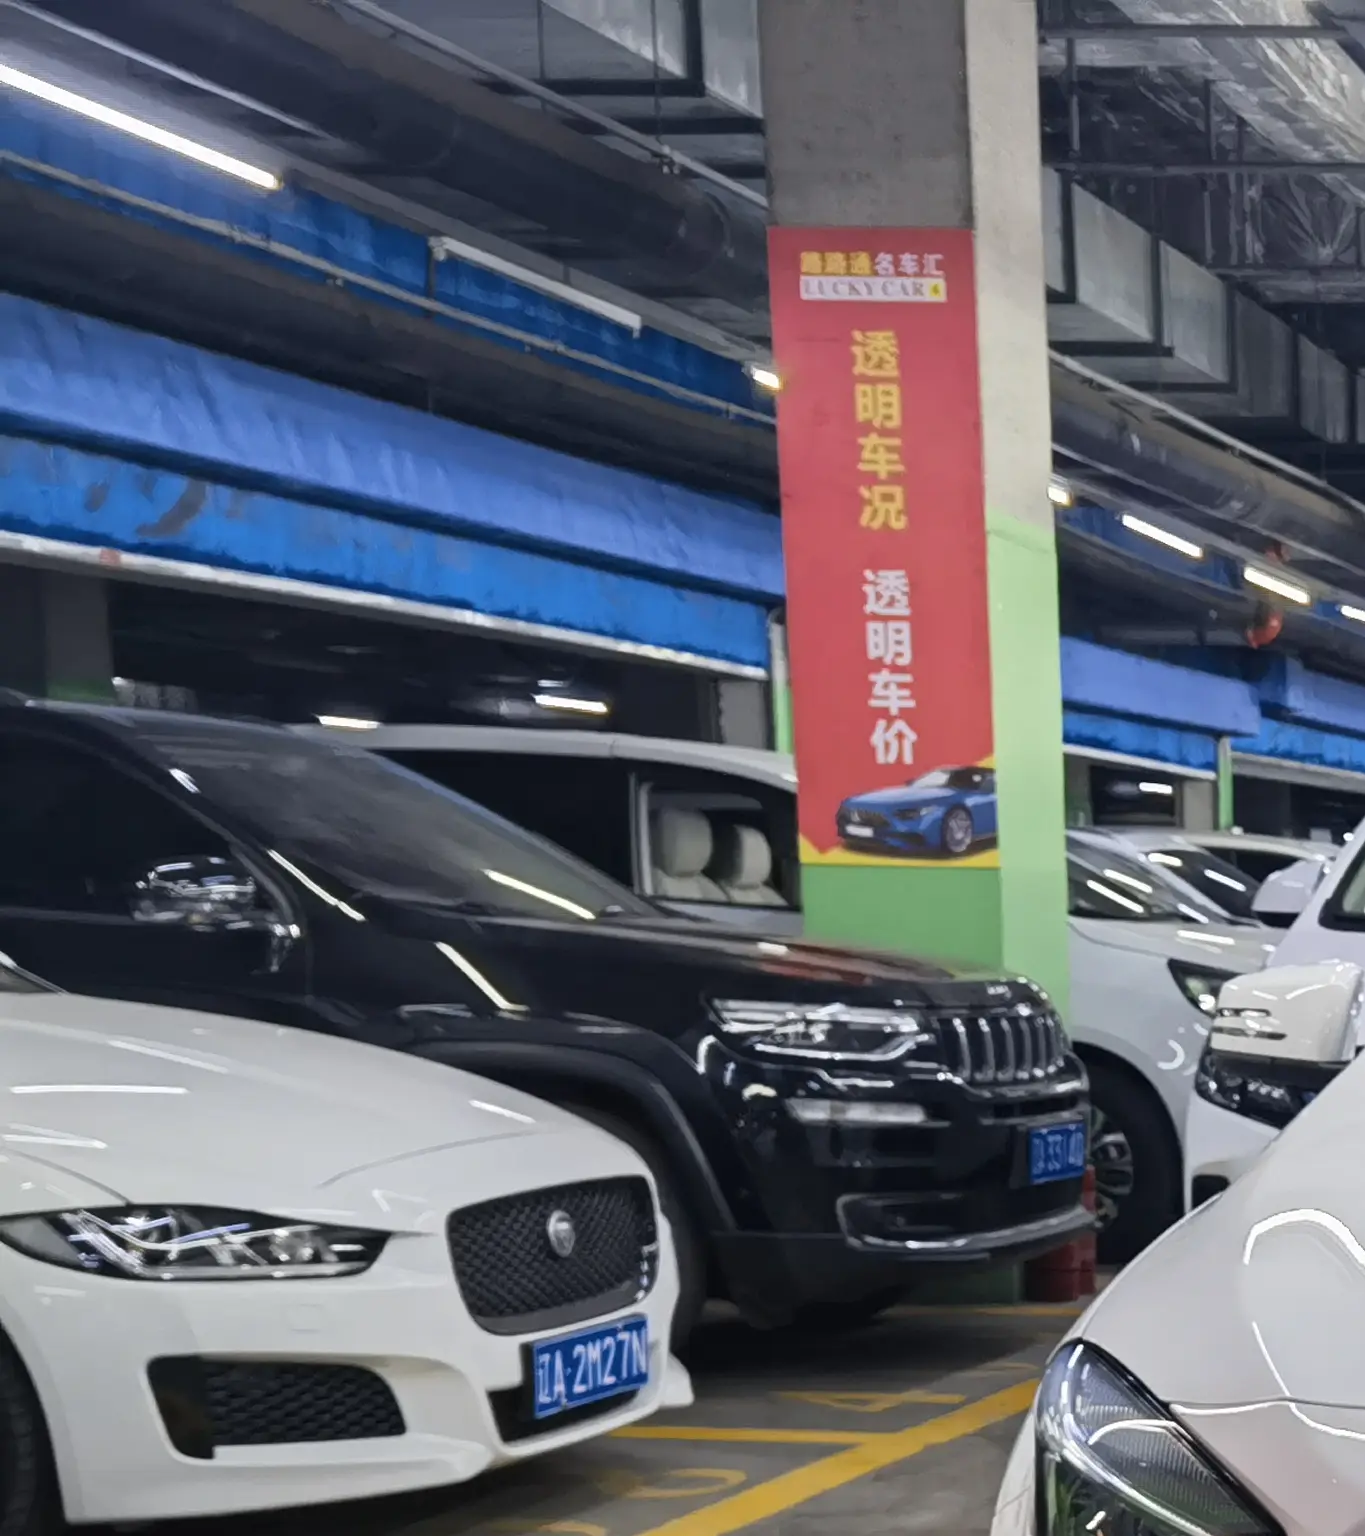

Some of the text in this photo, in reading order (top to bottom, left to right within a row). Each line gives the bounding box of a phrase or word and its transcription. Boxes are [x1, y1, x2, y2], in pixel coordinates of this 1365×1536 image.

[803, 279, 925, 298] LUCKY CAR
[850, 329, 918, 766] 透明车况 透明车价
